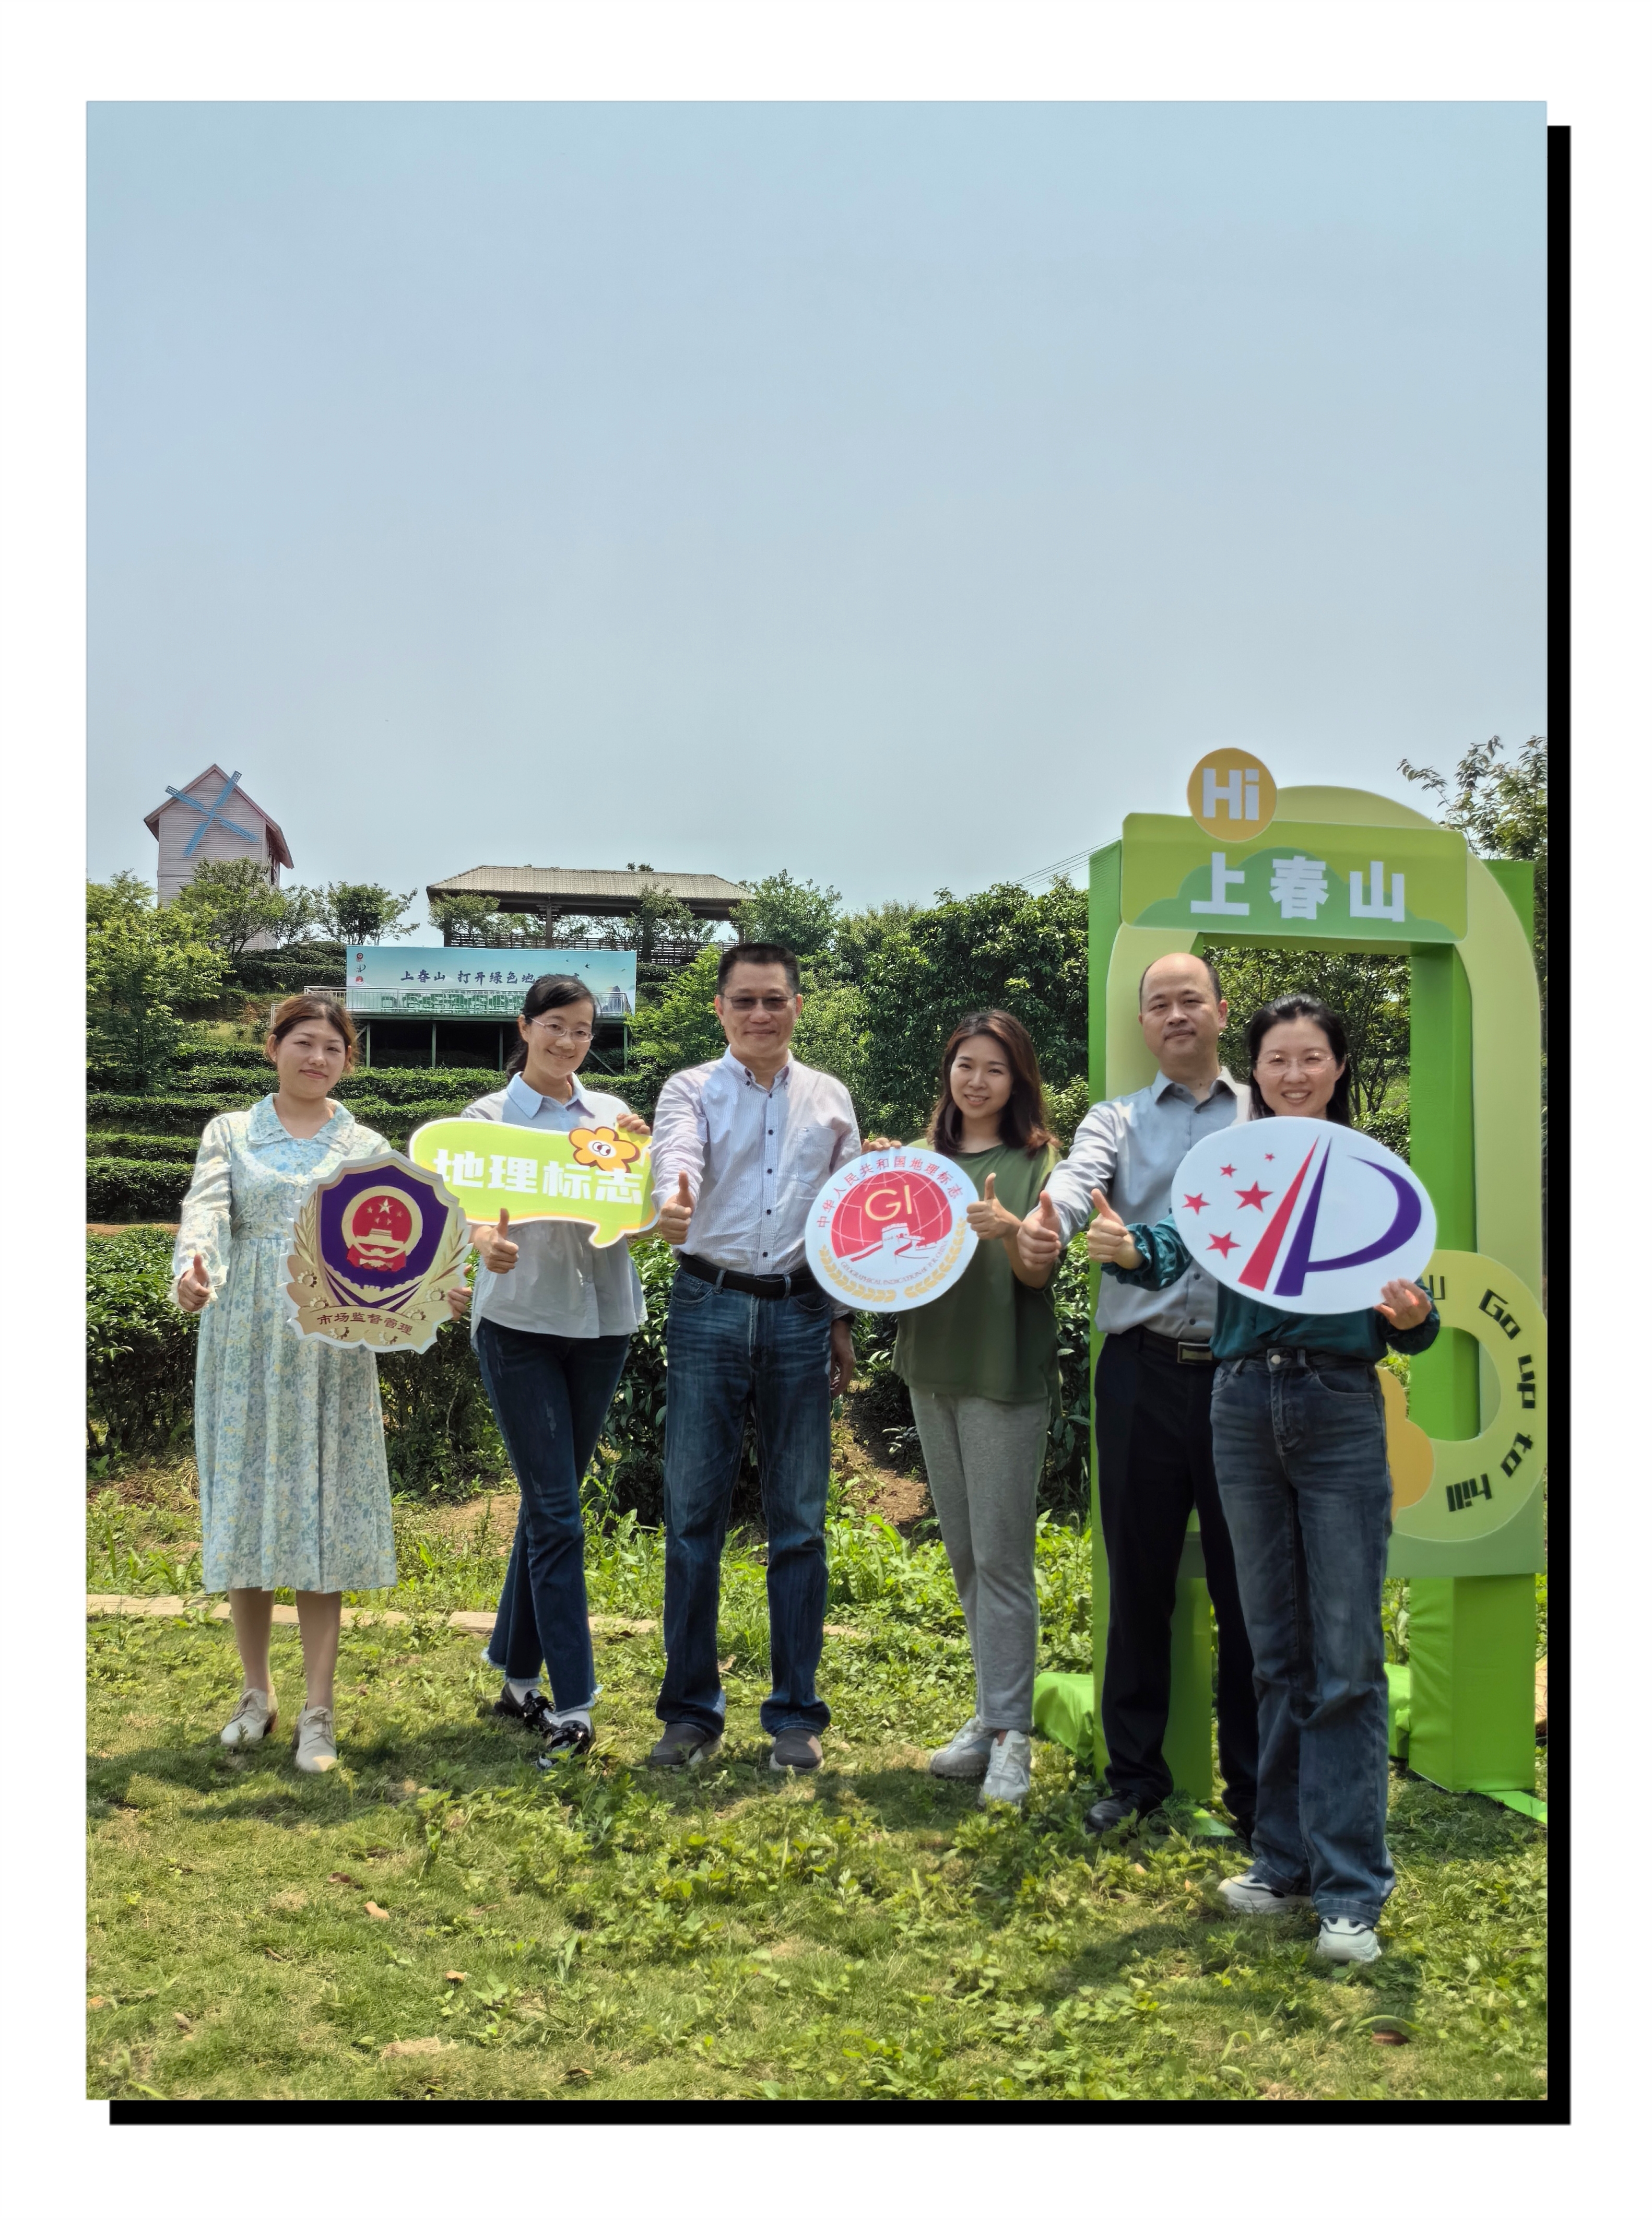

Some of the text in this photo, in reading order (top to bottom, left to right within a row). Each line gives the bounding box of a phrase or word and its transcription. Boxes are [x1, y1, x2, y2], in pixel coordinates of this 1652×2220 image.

[1202, 768, 1259, 821] Hi
[1190, 852, 1405, 923] 上春山
[400, 969, 580, 987] 上春山 打开绿色地
[433, 1148, 643, 1205] 地理标志
[817, 1155, 963, 1228] 中华人民共和国地理标志
[865, 1184, 913, 1221] GI
[316, 1312, 414, 1336] 市场监督管理
[1445, 1289, 1536, 1513] Go up to hill
